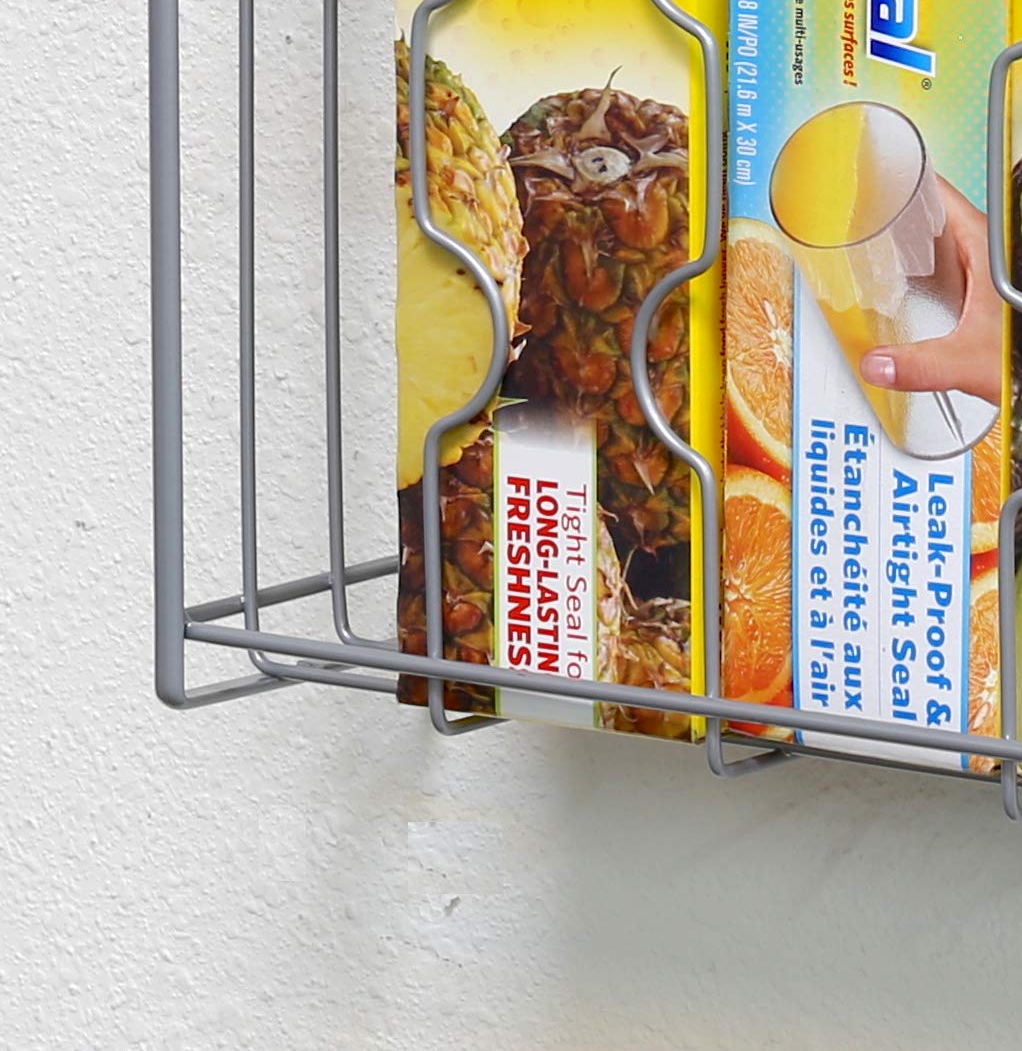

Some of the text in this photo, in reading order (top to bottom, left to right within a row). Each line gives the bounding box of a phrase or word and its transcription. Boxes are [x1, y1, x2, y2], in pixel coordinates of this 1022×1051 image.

[737, 14, 759, 57] IN/PO
[792, 7, 807, 86] multi-usages
[841, 12, 857, 77] surfaces
[733, 61, 758, 100] (21.6
[737, 103, 753, 118] m
[737, 121, 757, 134] X
[737, 139, 757, 156] 30
[733, 159, 757, 187] cm)
[805, 419, 835, 556] liquides
[507, 476, 531, 671] FRESHNES
[537, 480, 559, 673] LONG-LASTIN
[562, 484, 588, 639] Tight Seal
[810, 565, 833, 599] et
[843, 423, 875, 711] Étanchéité aux
[810, 609, 834, 629] à
[886, 469, 918, 722] Airtight Seal
[926, 473, 954, 726] Leak-Proof &
